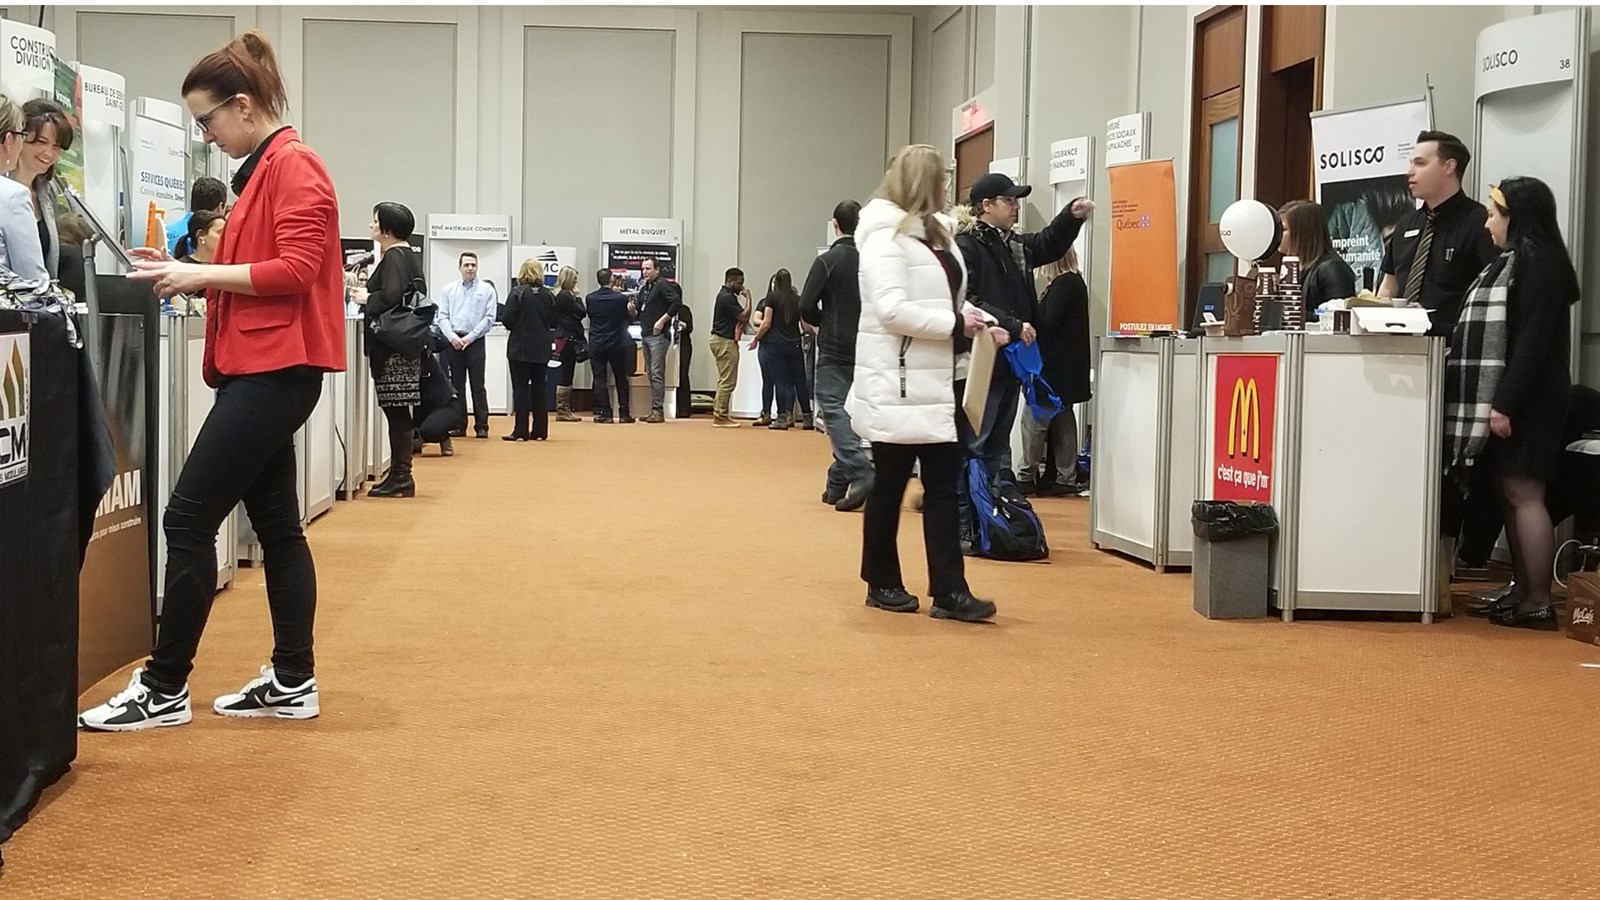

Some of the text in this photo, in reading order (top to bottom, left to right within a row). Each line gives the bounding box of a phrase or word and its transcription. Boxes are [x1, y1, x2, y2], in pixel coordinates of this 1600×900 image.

[1483, 49, 1518, 72] SOLISCO
[1559, 58, 1571, 70] 38
[85, 82, 108, 96] BUREAU
[1319, 145, 1385, 170] SOLISCO
[140, 171, 164, 187] SERVICES
[1116, 218, 1140, 231] Québec
[641, 228, 666, 236] DUQUET
[1119, 322, 1147, 331] POSTULEZ
[1217, 464, 1233, 482] c'est
[1234, 469, 1242, 487] ça
[1243, 472, 1256, 488] que
